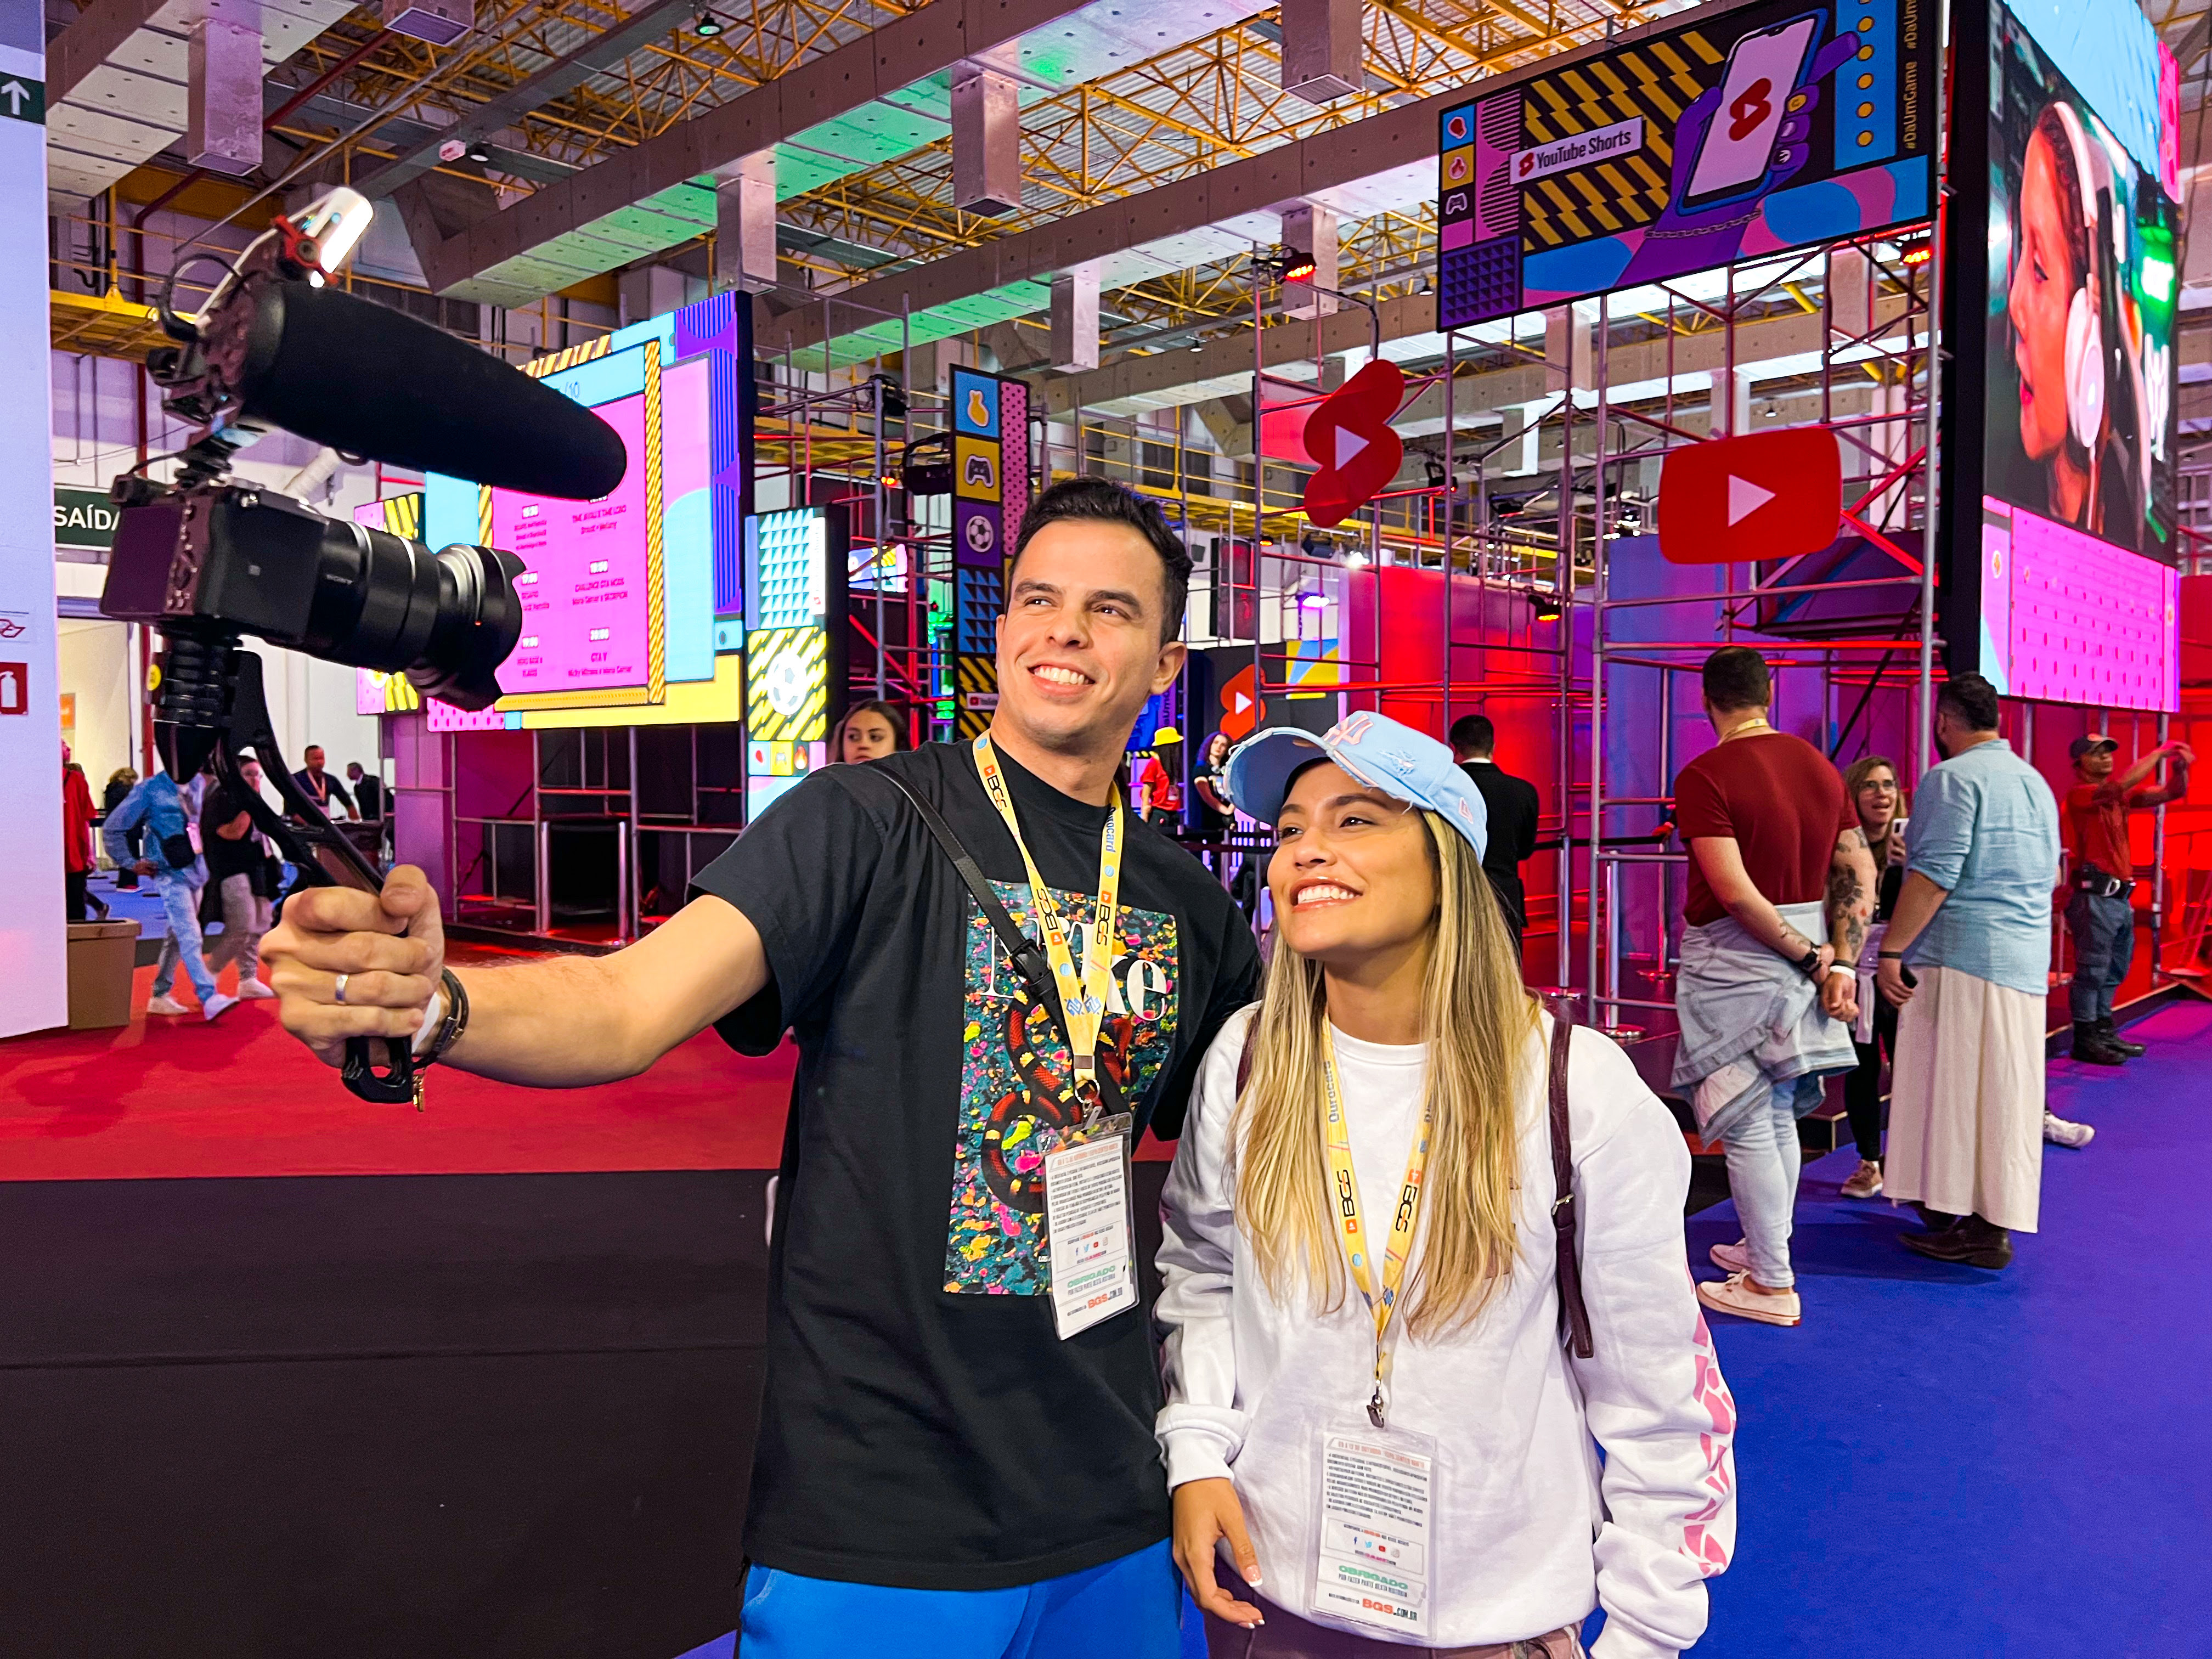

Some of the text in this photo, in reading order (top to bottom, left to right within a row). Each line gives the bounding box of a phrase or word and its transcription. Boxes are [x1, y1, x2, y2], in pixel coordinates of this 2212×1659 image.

[1903, 61, 1917, 150] #DaUmGame
[1537, 131, 1632, 169] YouTube Shorts
[987, 774, 1007, 812] BGS
[1036, 888, 1058, 931] BGS
[1096, 904, 1111, 946] BGS
[1336, 1169, 1356, 1217] BGS
[1395, 1184, 1418, 1233] BGS
[1067, 1265, 1116, 1289] OBRIGADO
[1339, 1565, 1408, 1590] OBRIGADO
